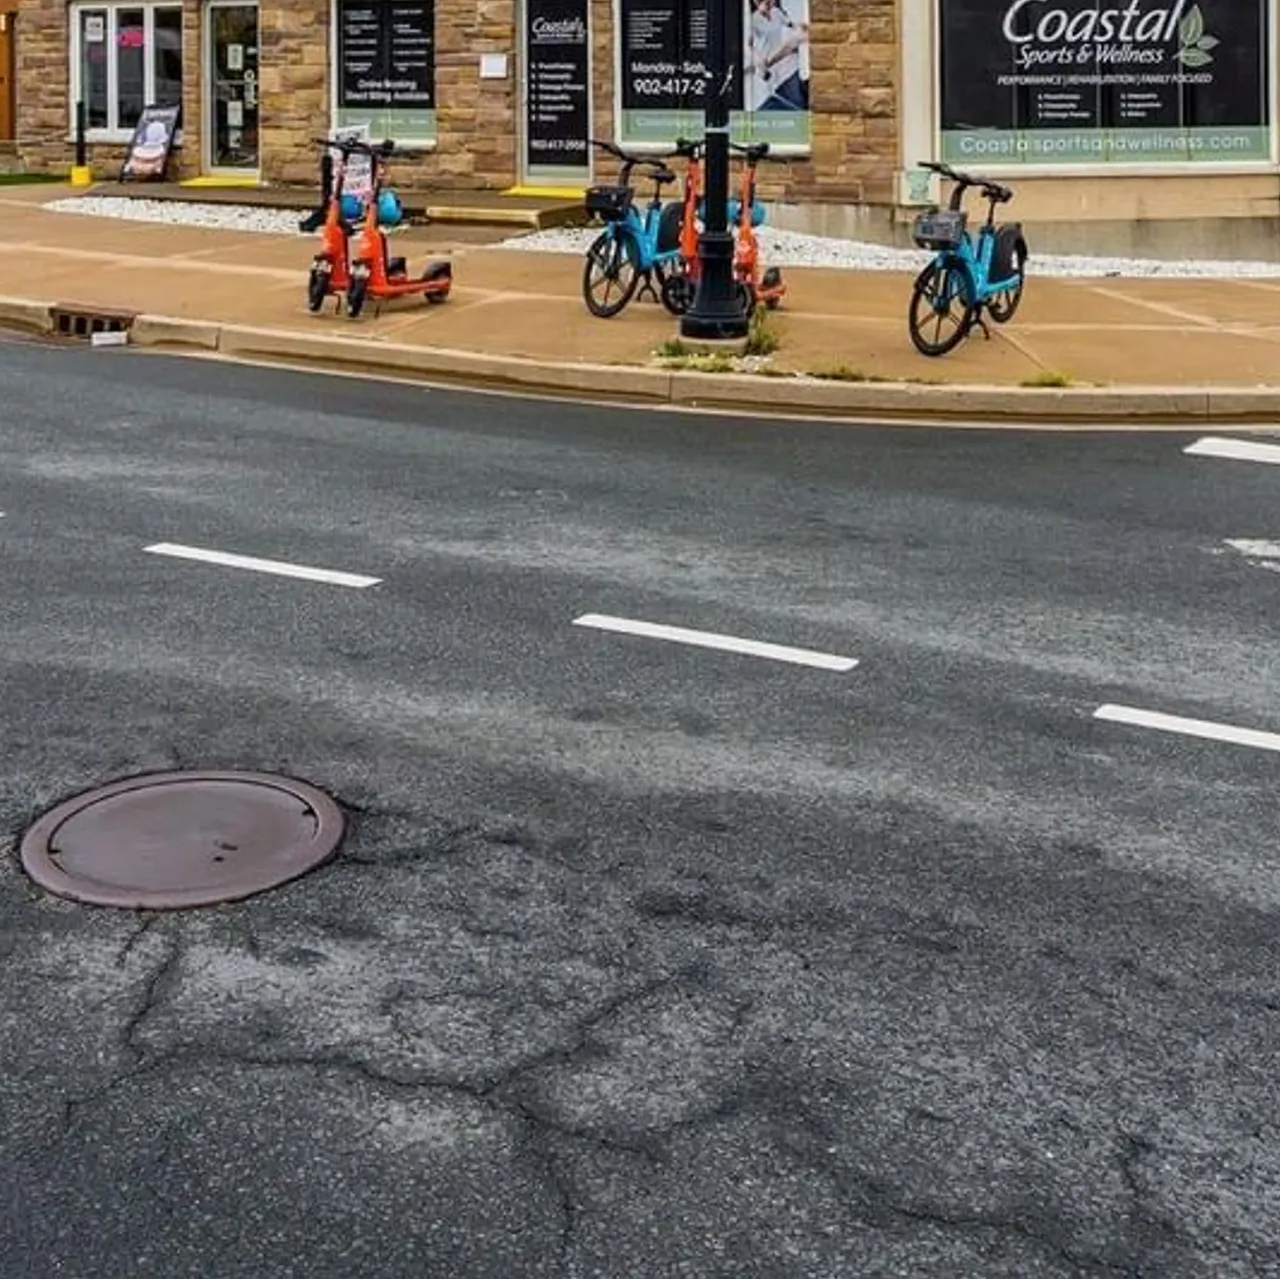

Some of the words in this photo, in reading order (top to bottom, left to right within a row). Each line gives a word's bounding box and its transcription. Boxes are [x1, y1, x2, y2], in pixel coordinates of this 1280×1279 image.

[1016, 43, 1074, 68] Sports
[1075, 44, 1093, 63] &
[1094, 43, 1164, 64] Wellness
[631, 62, 676, 75] Monday
[633, 79, 706, 94] 902-417-2
